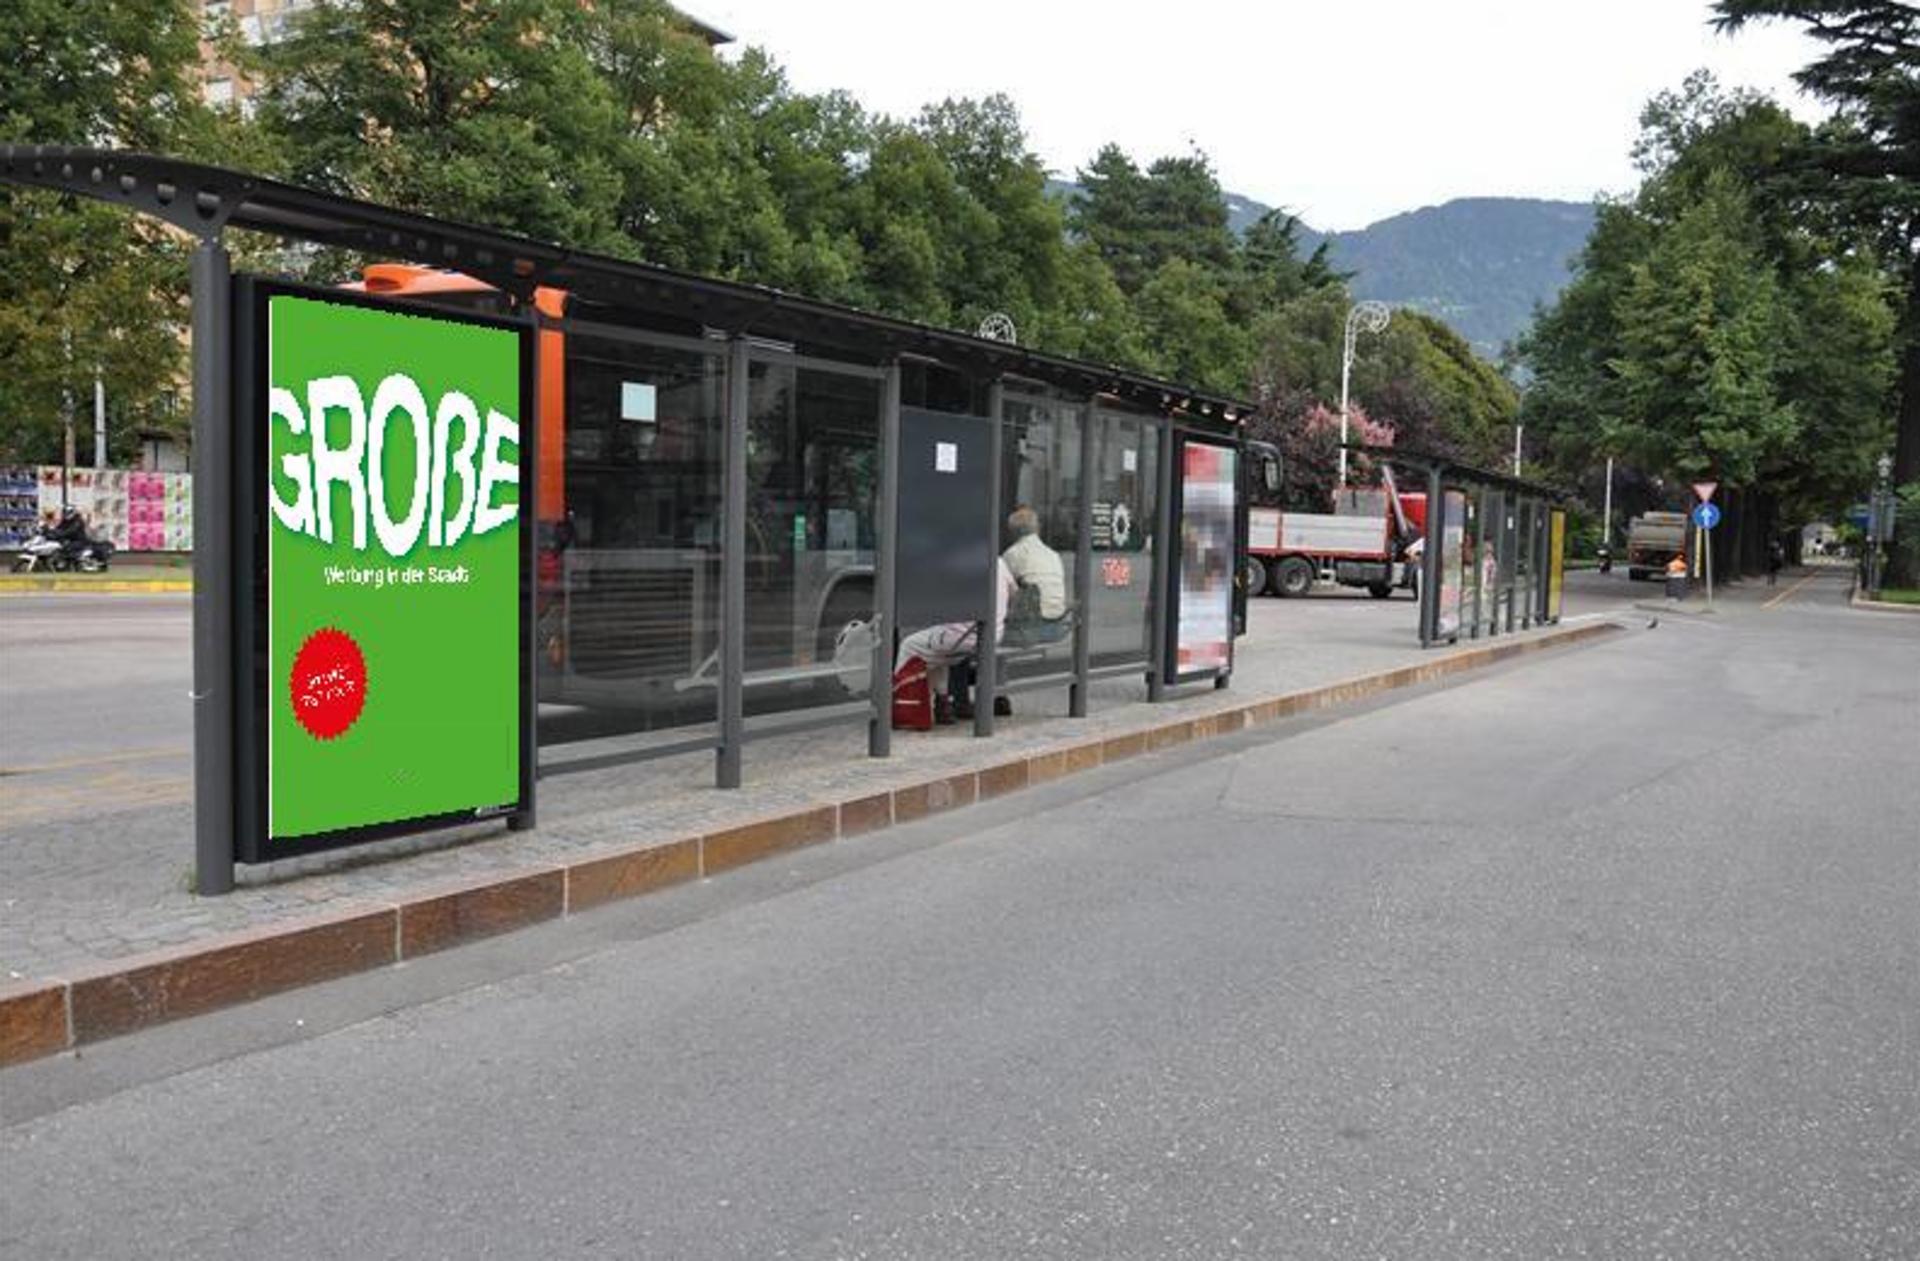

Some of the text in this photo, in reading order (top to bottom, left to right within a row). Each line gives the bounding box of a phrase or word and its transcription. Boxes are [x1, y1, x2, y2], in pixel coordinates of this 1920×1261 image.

[324, 564, 469, 589] Werbung in der Stadt
